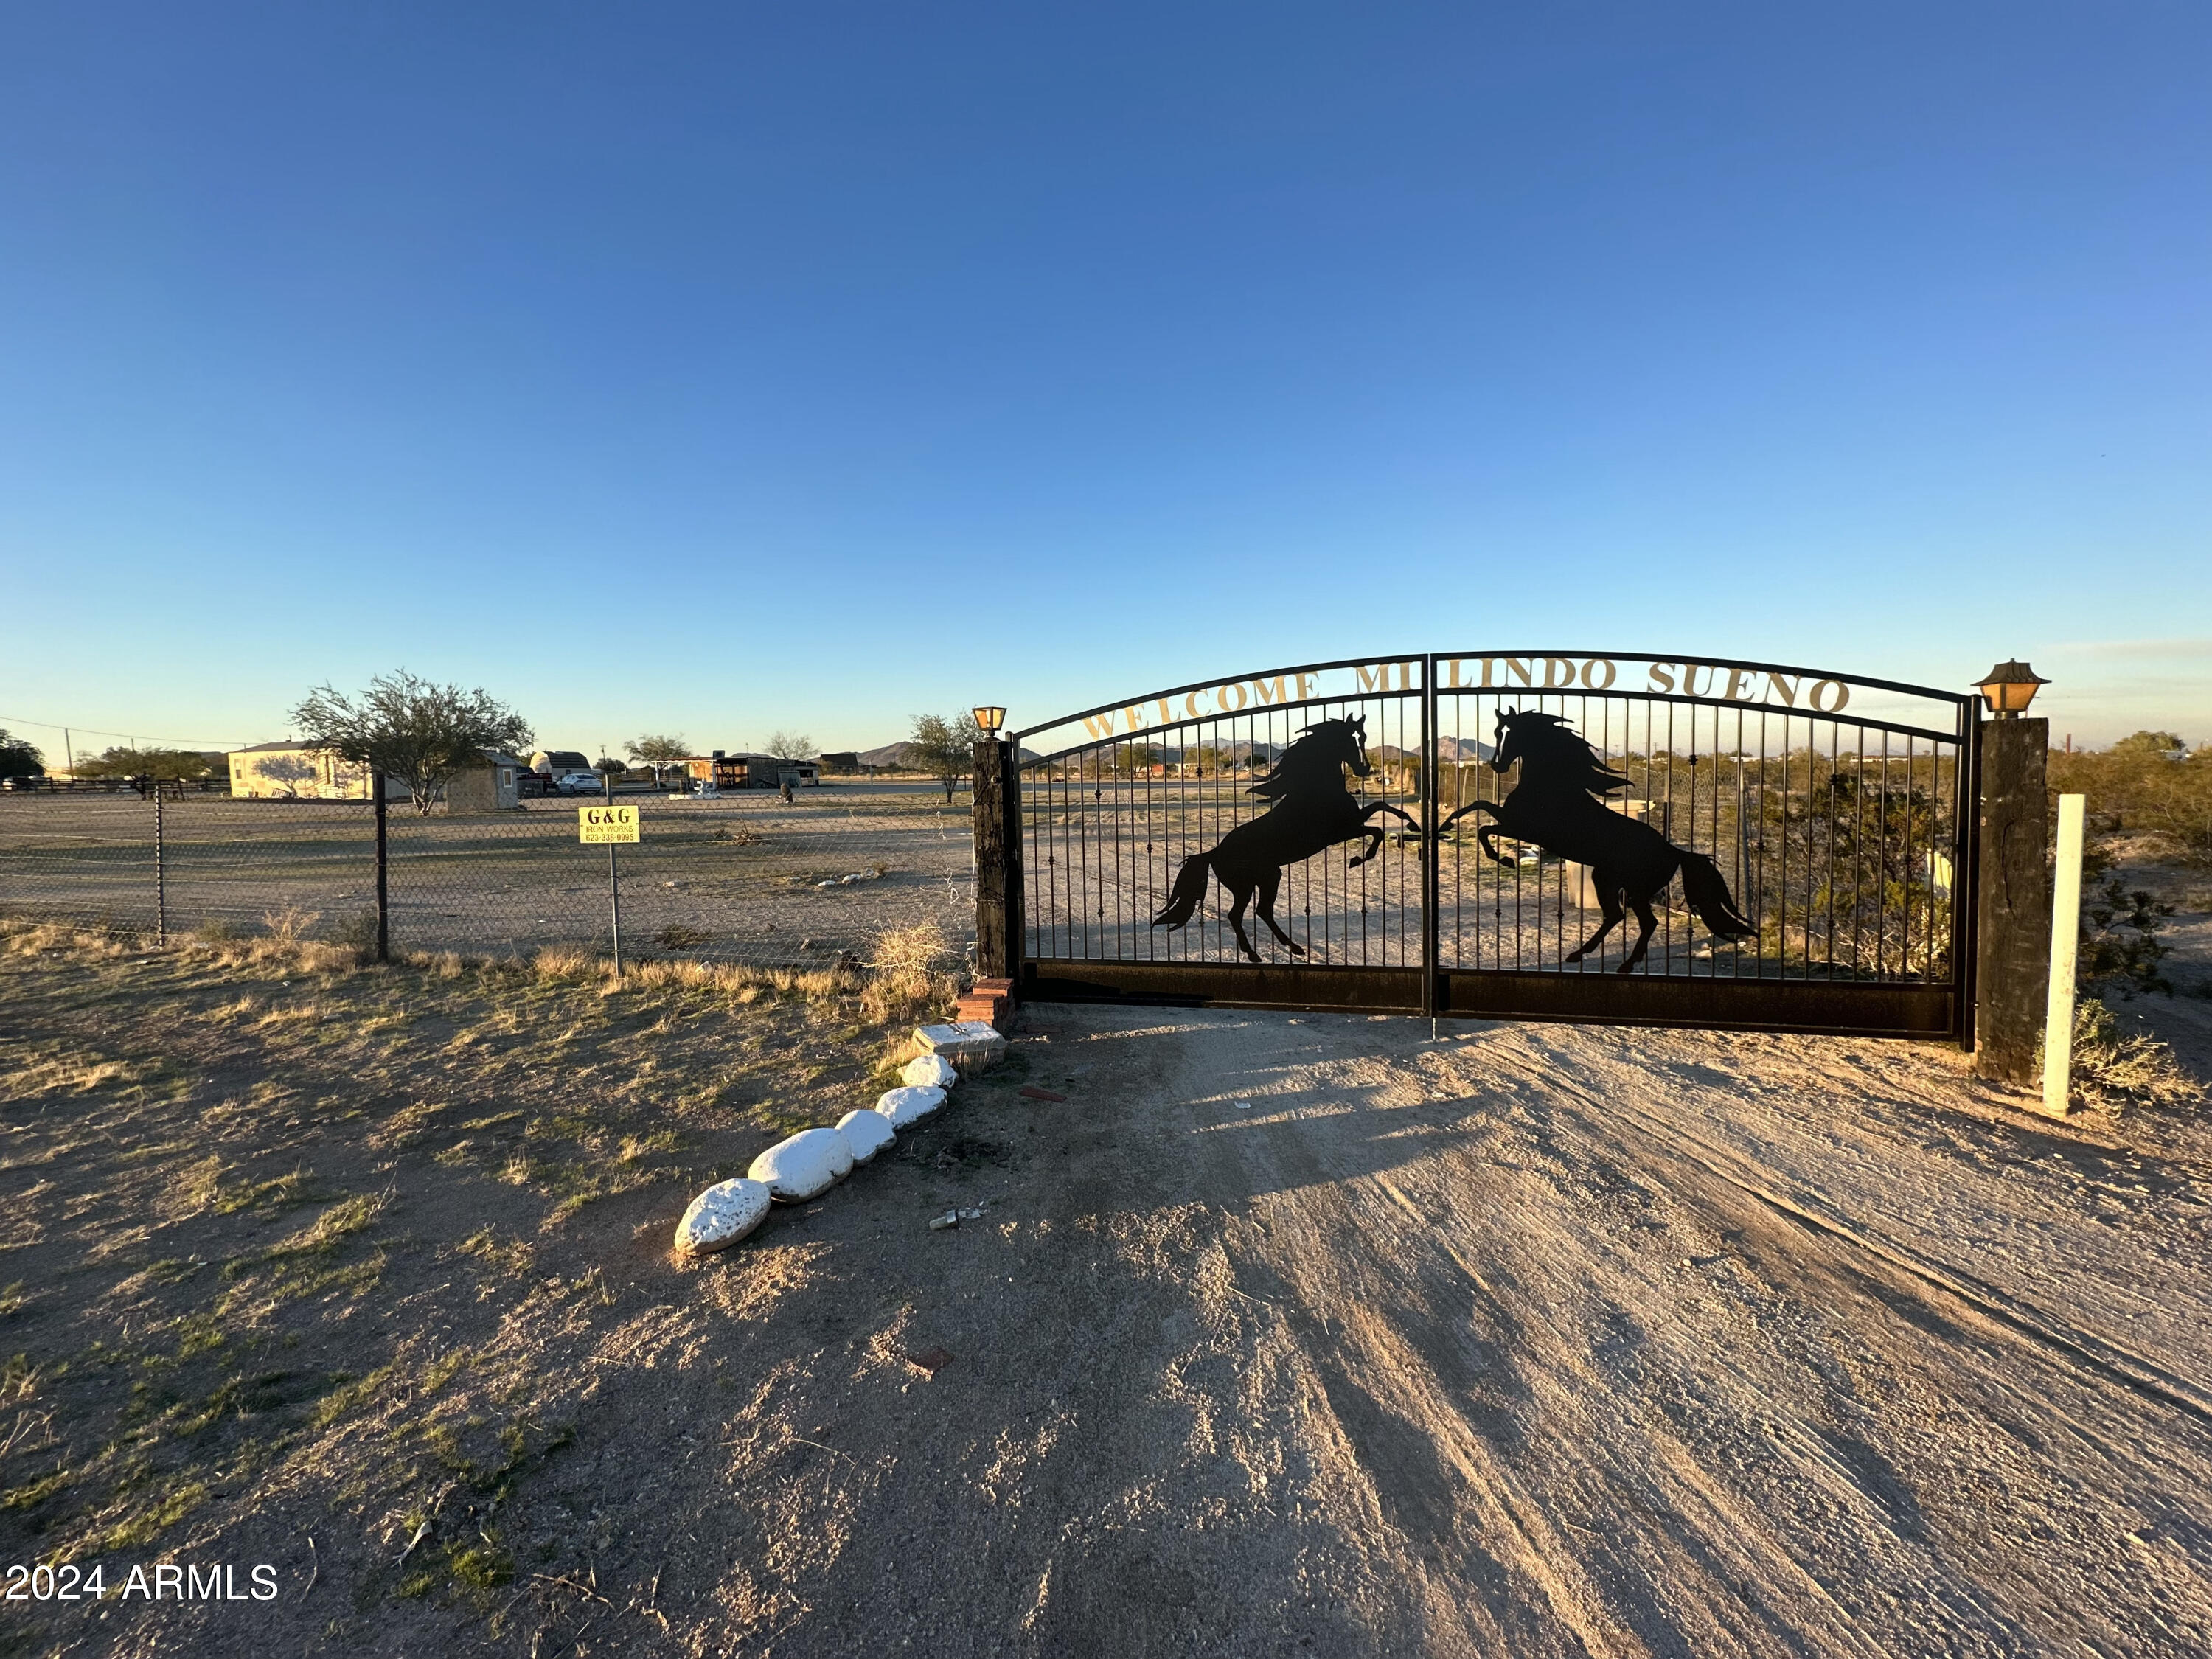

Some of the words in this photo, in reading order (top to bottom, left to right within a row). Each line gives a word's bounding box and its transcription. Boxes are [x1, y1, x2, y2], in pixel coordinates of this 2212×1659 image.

[1080, 672, 1319, 741] WELCOME
[1354, 662, 1413, 694] MI
[1447, 658, 1617, 689] LINDO
[1647, 662, 1850, 713] SUENO
